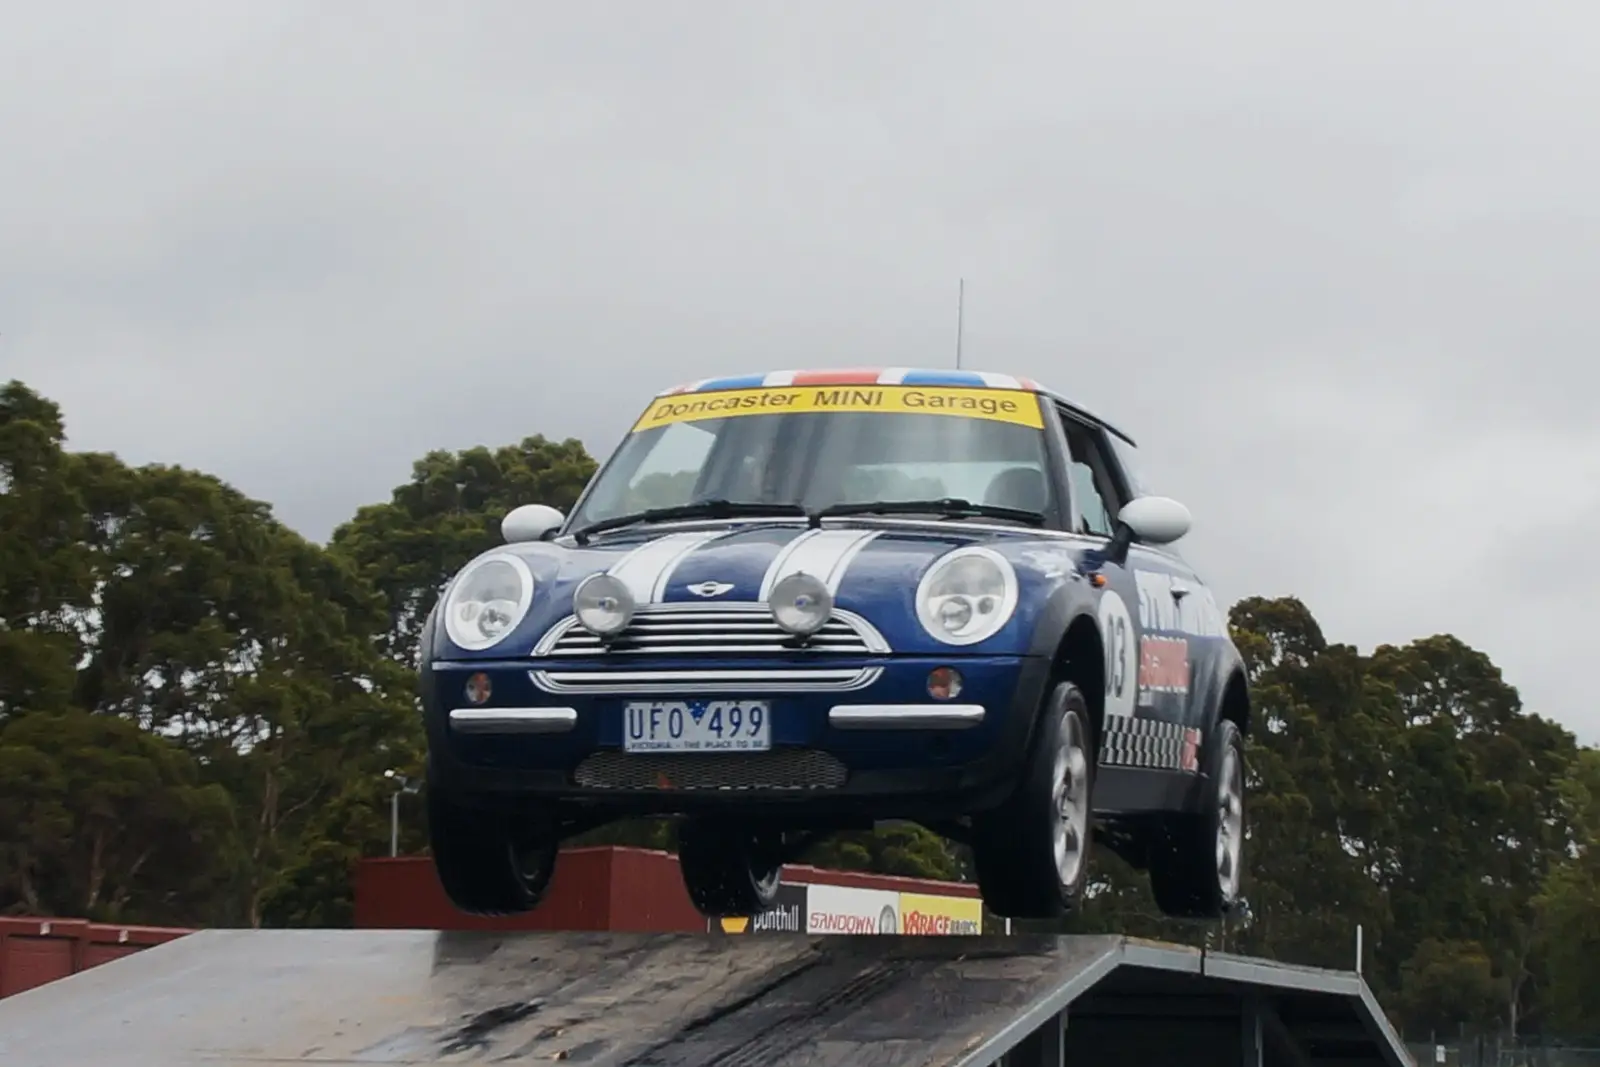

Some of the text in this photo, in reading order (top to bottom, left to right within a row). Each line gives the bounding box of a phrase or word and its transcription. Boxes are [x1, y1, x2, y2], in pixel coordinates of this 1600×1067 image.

[653, 390, 1018, 421] Doncaster MINI Garage
[629, 706, 763, 739] UFO 499
[753, 904, 799, 932] punthill
[810, 912, 876, 934] SANDOWN
